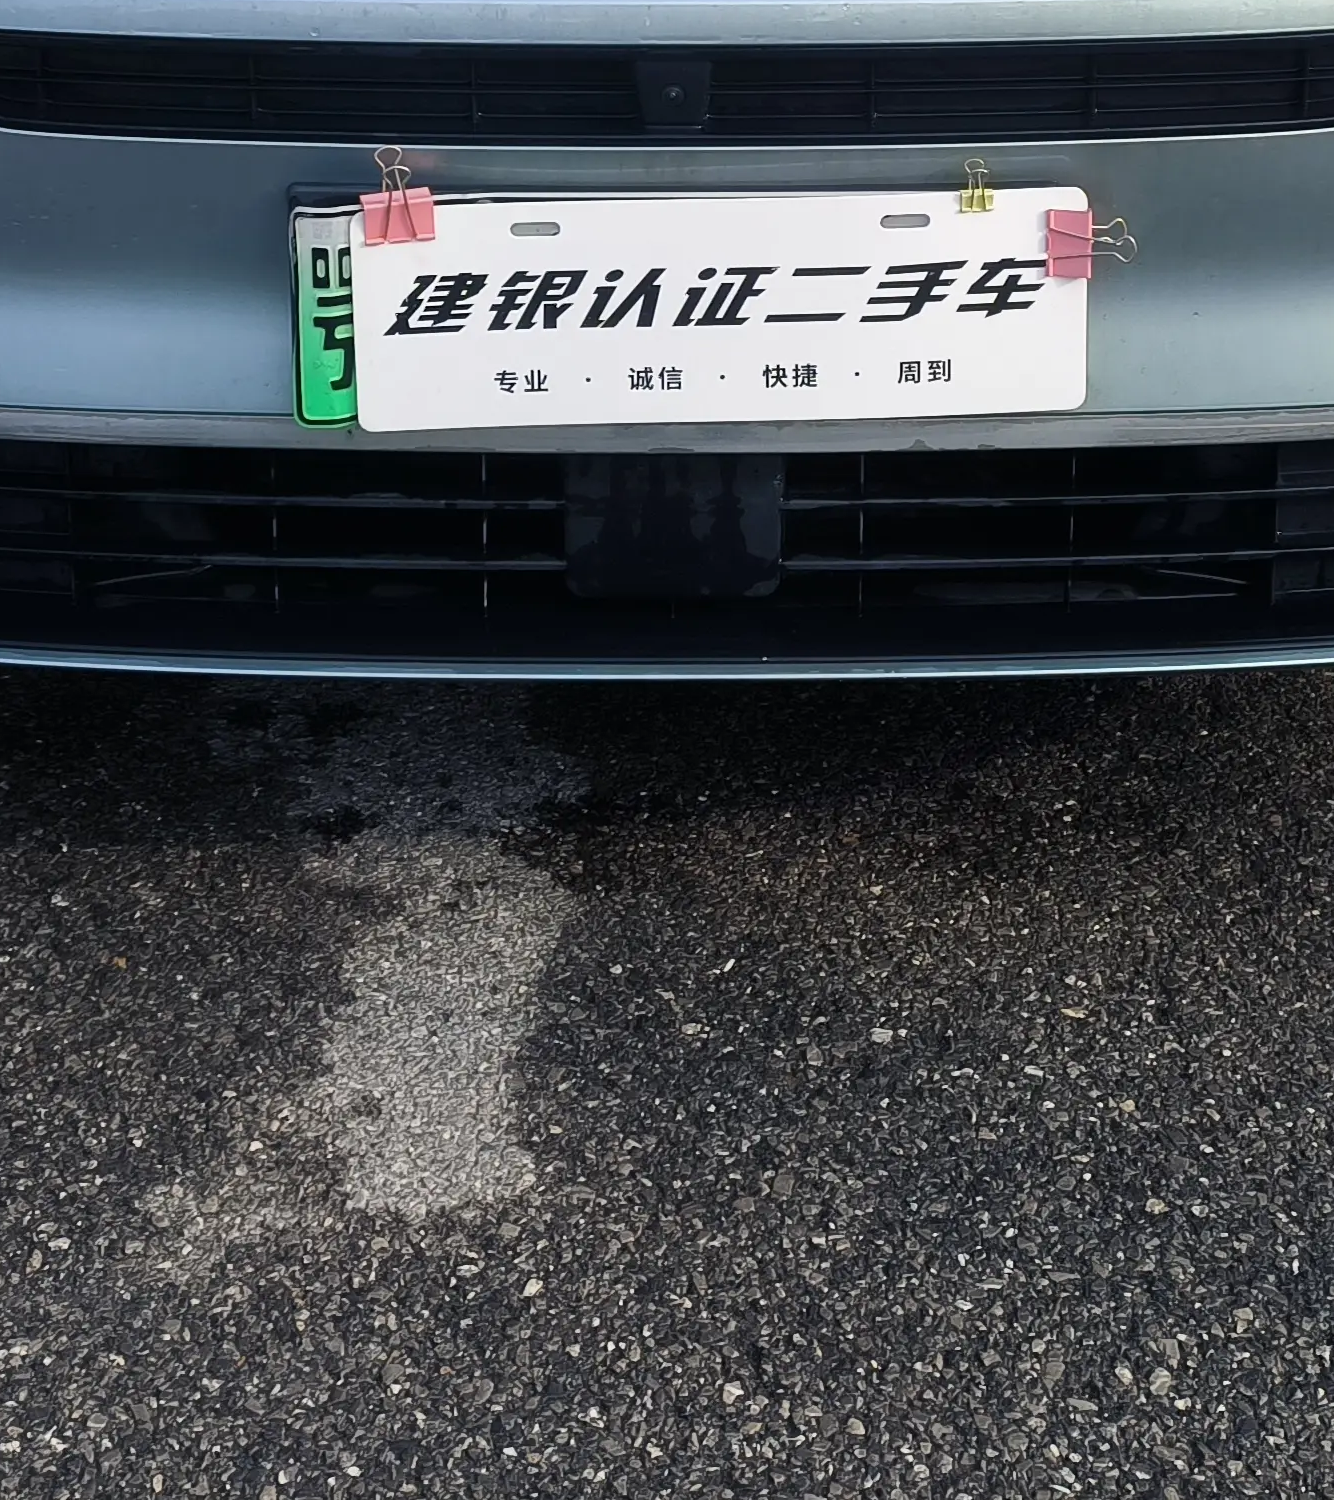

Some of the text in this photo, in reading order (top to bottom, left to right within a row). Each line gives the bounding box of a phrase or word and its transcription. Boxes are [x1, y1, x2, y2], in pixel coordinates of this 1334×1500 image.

[384, 257, 1047, 337] 建银认证二手车
[493, 358, 953, 395] 专业 诚信 快捷 周到
